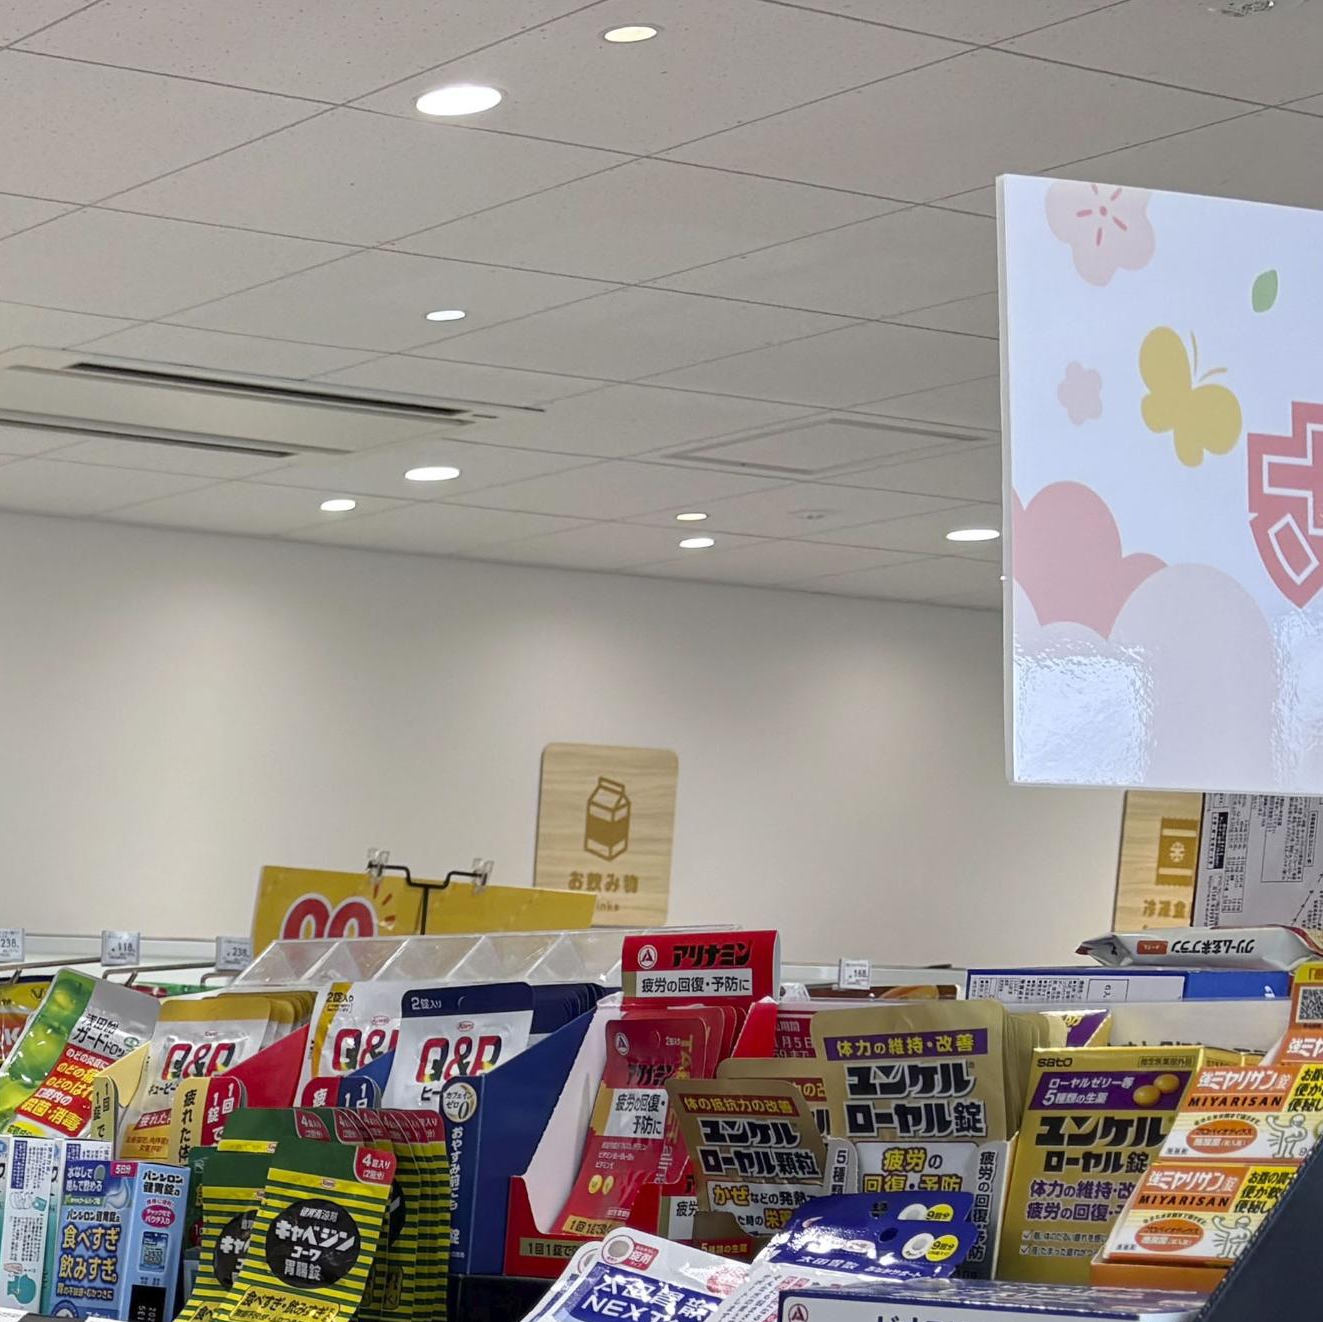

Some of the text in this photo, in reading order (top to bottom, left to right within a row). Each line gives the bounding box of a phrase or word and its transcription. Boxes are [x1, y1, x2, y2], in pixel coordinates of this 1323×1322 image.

[567, 871, 640, 895] お飲み物
[673, 943, 754, 966] アリナミン
[642, 977, 751, 994] 疲労の回復・予防に
[837, 1033, 976, 1057] 体力の維持・改善
[415, 1035, 502, 1083] Q&P
[1037, 1058, 1073, 1068] sato
[845, 1060, 976, 1099] ユンケル
[1049, 1076, 1134, 1089] ローヤルゼリー等
[1197, 1071, 1291, 1090] 強ミヤリサン錠
[684, 1096, 795, 1115] 体の抵抗力の改善
[1043, 1090, 1108, 1106] 5種類の生薬
[1188, 1096, 1282, 1107] MIYARISAN
[633, 1117, 662, 1135] 予防に
[844, 1100, 987, 1137] ローヤル錠
[699, 1118, 799, 1146] ユンケル
[1035, 1115, 1167, 1146] ユンケル
[703, 1148, 821, 1177] ローヤル顆粒
[882, 1149, 943, 1172] 疲労の
[1043, 1151, 1148, 1174] ローヤル錠
[142, 1170, 183, 1184] パンシロン
[1146, 1171, 1238, 1192] 強ミヤリサン錠
[1139, 1195, 1229, 1206] MIYARISAN
[62, 1224, 122, 1251] 食べすぎ
[275, 1220, 355, 1251] キャベジン
[291, 1246, 322, 1261] コーワ
[58, 1254, 118, 1283] 飲みすぎ。
[284, 1259, 322, 1281] 胃腸錠
